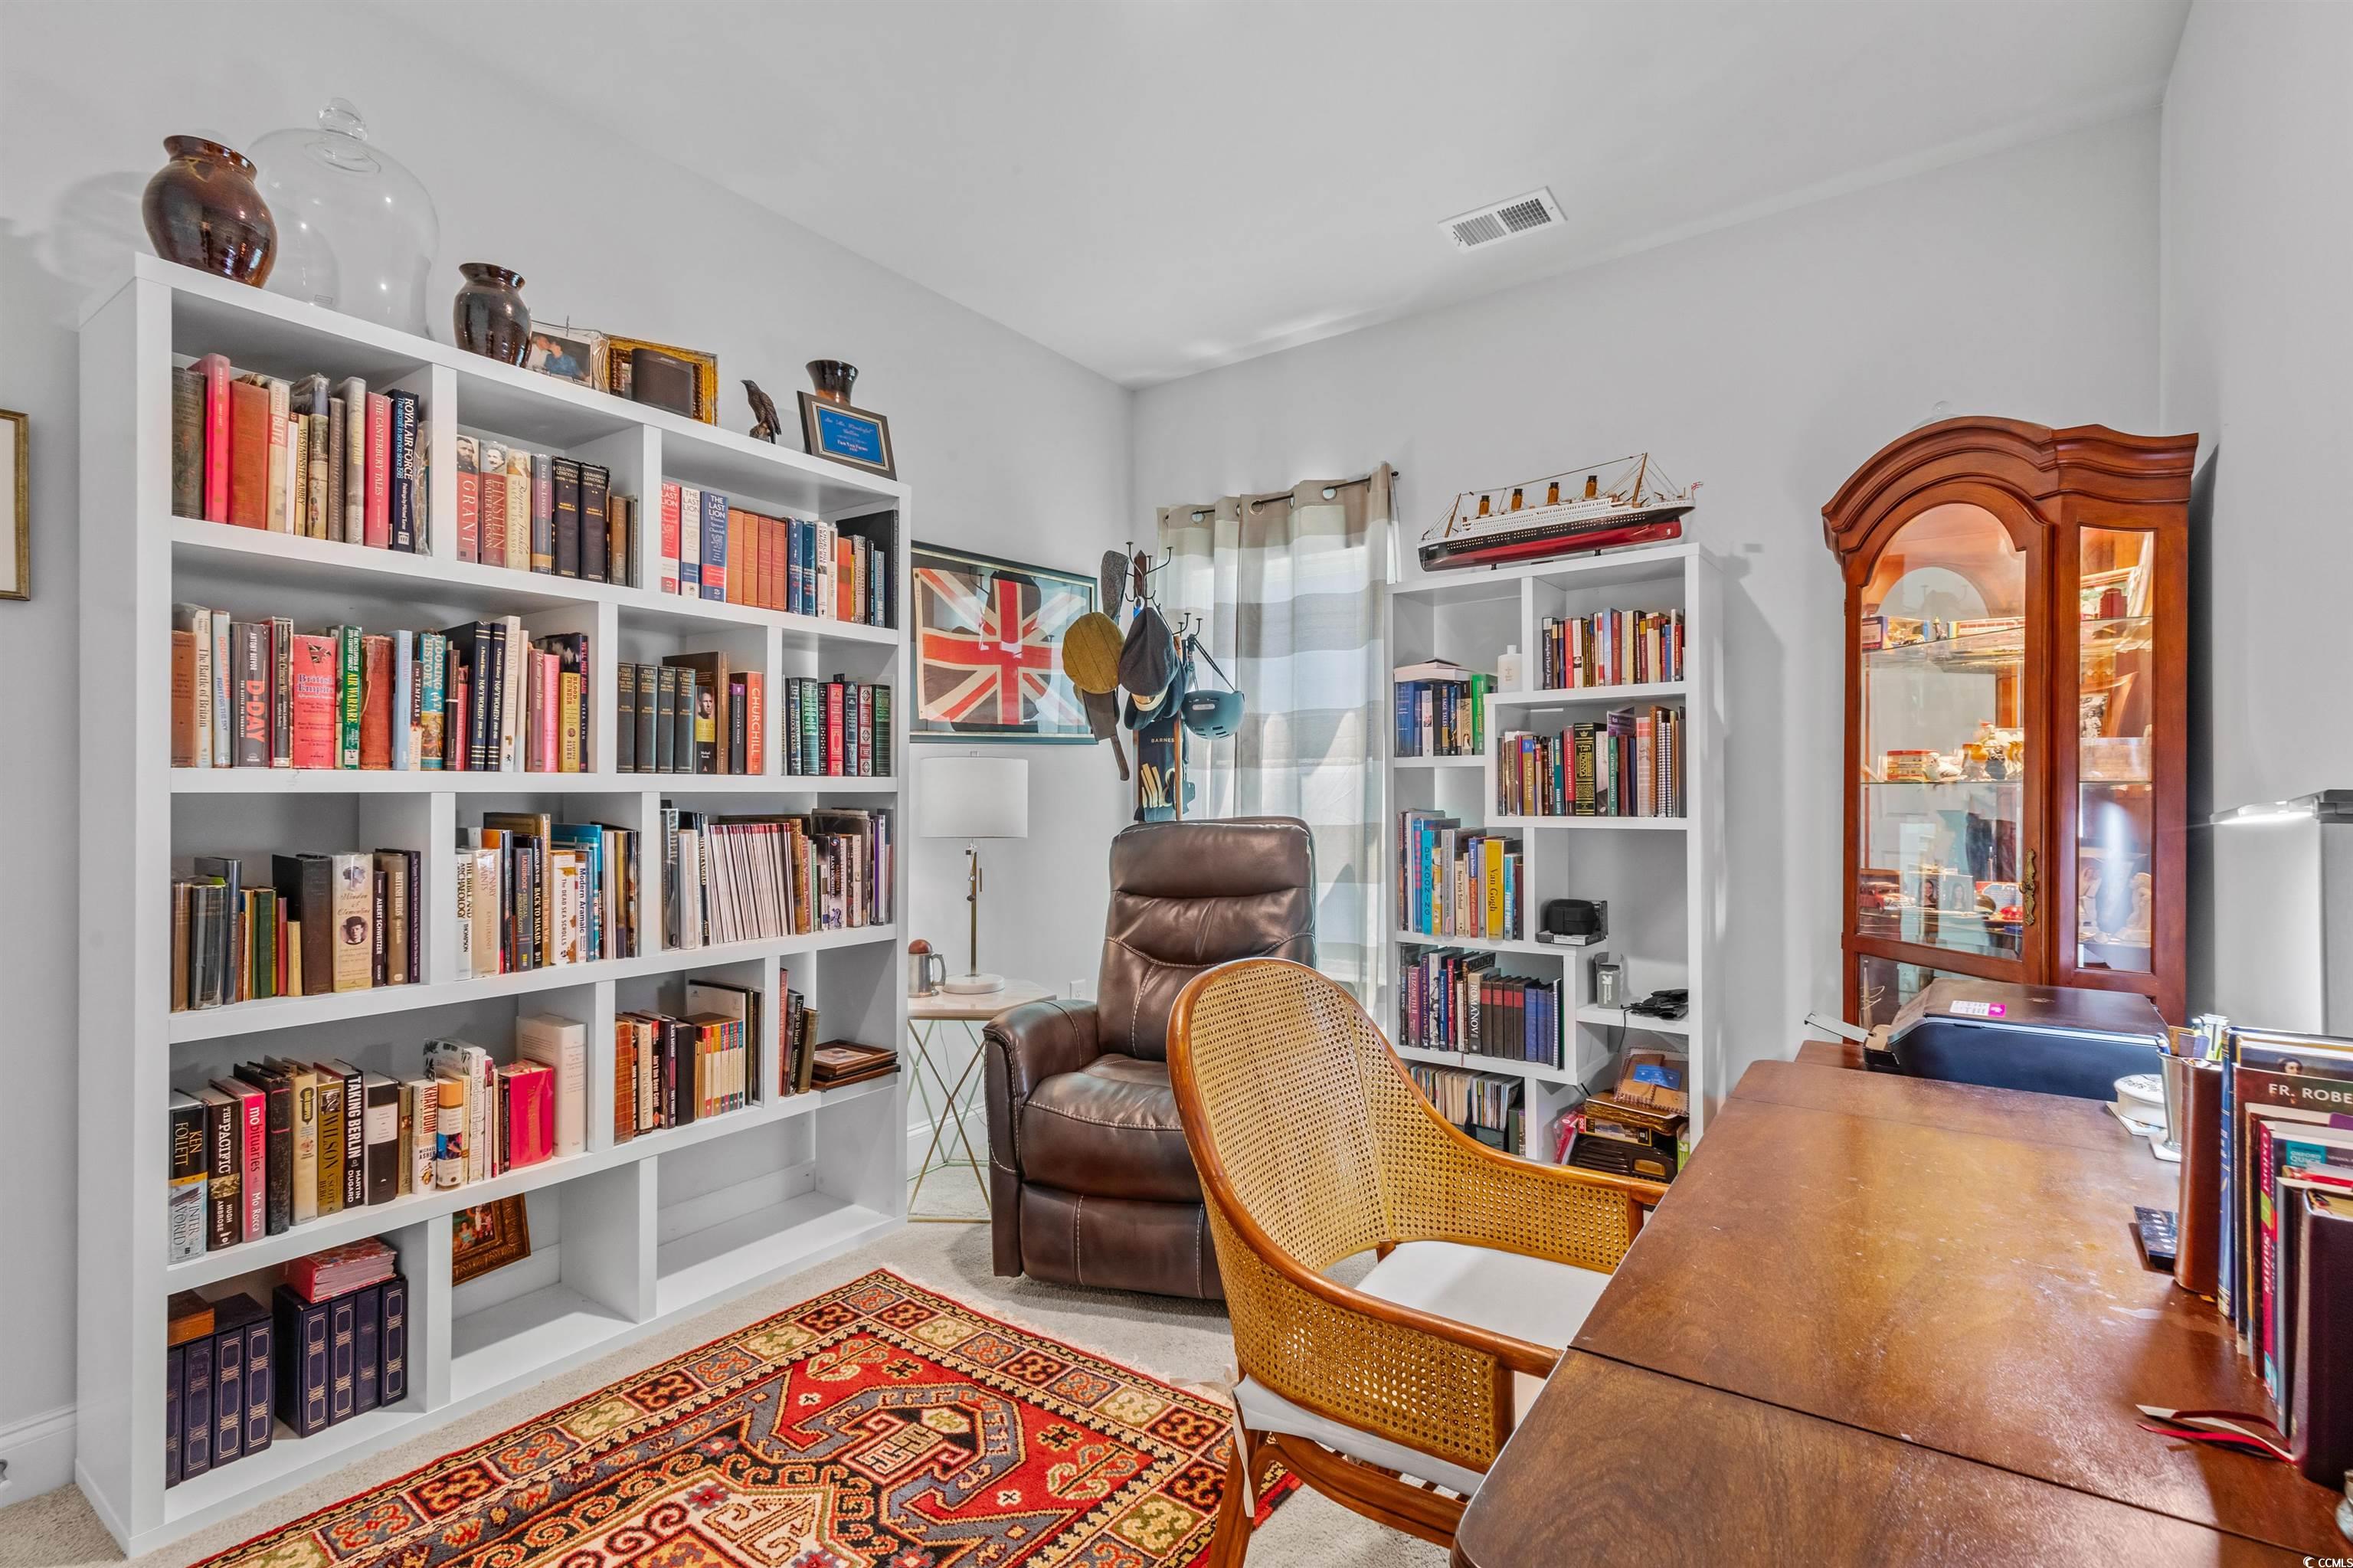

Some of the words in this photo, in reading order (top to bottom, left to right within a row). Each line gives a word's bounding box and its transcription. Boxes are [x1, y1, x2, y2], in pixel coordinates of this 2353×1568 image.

[375, 399, 384, 415] THE
[404, 398, 414, 428] ROYAL
[272, 417, 284, 444] BLITZ
[375, 417, 383, 470] CANTERBURY
[404, 428, 413, 447] AIR
[298, 428, 306, 479] WESTMINSTER
[404, 447, 413, 480] FORCE
[375, 473, 383, 496] TALES
[485, 479, 493, 507] WALTER
[463, 480, 476, 545] GRANT
[709, 502, 725, 512] LAST
[711, 495, 724, 504] THE
[493, 480, 505, 550] EINSTEIN
[709, 509, 725, 519] LION
[485, 510, 493, 548] ISAACSON
[198, 649, 209, 663] The
[279, 653, 287, 662] The
[424, 638, 433, 687] HISTORY
[435, 638, 443, 689] LOOKING
[198, 664, 209, 686] Battle
[279, 663, 287, 684] Crimean
[347, 673, 358, 686] AIR
[279, 685, 287, 695] War
[434, 696, 443, 709] AT
[198, 699, 209, 727] Britain
[246, 679, 265, 742] D-DAY
[347, 687, 358, 723] WARFARE
[751, 687, 760, 755] CHURCHILL
[1425, 846, 1430, 860] DE
[395, 871, 404, 896] BRITISH
[457, 862, 466, 918] ARCHAEOLOGY
[1490, 868, 1498, 885] Van
[534, 907, 541, 915] TO
[1488, 887, 1497, 912] Gogh
[794, 1000, 803, 1020] Passage
[1470, 984, 1480, 1034] ROMANOV
[348, 1076, 362, 1118] TAKING
[472, 1075, 482, 1115] Medicinal
[2268, 1083, 2296, 1097] FR.
[222, 1105, 231, 1124] THE
[424, 1085, 437, 1134] KHARTOUM
[189, 1130, 202, 1153] KEN
[249, 1106, 263, 1172] mobituaries
[322, 1114, 339, 1169] WILSON
[347, 1118, 362, 1159] BERLIN
[472, 1116, 481, 1140] Herbs
[175, 1121, 188, 1166] FOLLETT
[218, 1123, 231, 1174] PACIFIC
[252, 1192, 261, 1206] Mo
[173, 1200, 187, 1246] WORLD
[251, 1209, 261, 1232] Rocca
